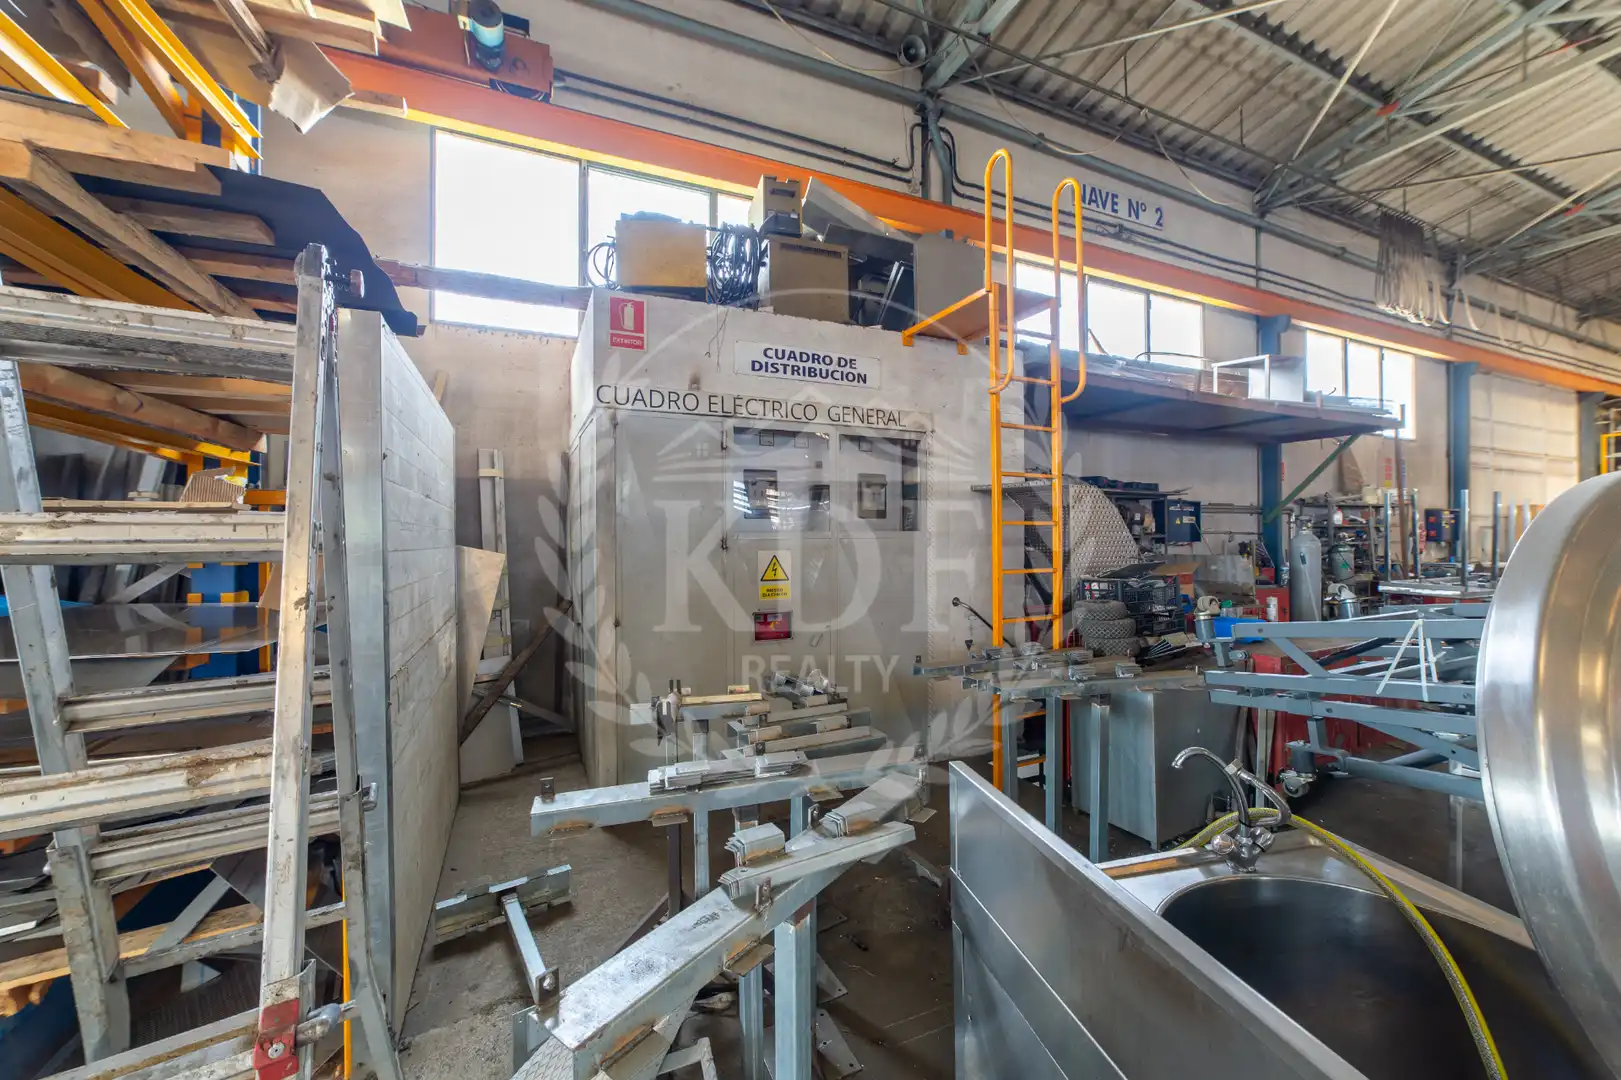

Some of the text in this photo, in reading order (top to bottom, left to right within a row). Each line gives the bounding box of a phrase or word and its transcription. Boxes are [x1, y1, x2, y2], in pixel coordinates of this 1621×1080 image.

[1155, 207, 1164, 227] 2
[763, 347, 858, 370] CUADRO DE
[751, 360, 867, 385] DISTRIBUCION
[596, 384, 907, 428] CUADRO ELÉCTRICO GENERAL
